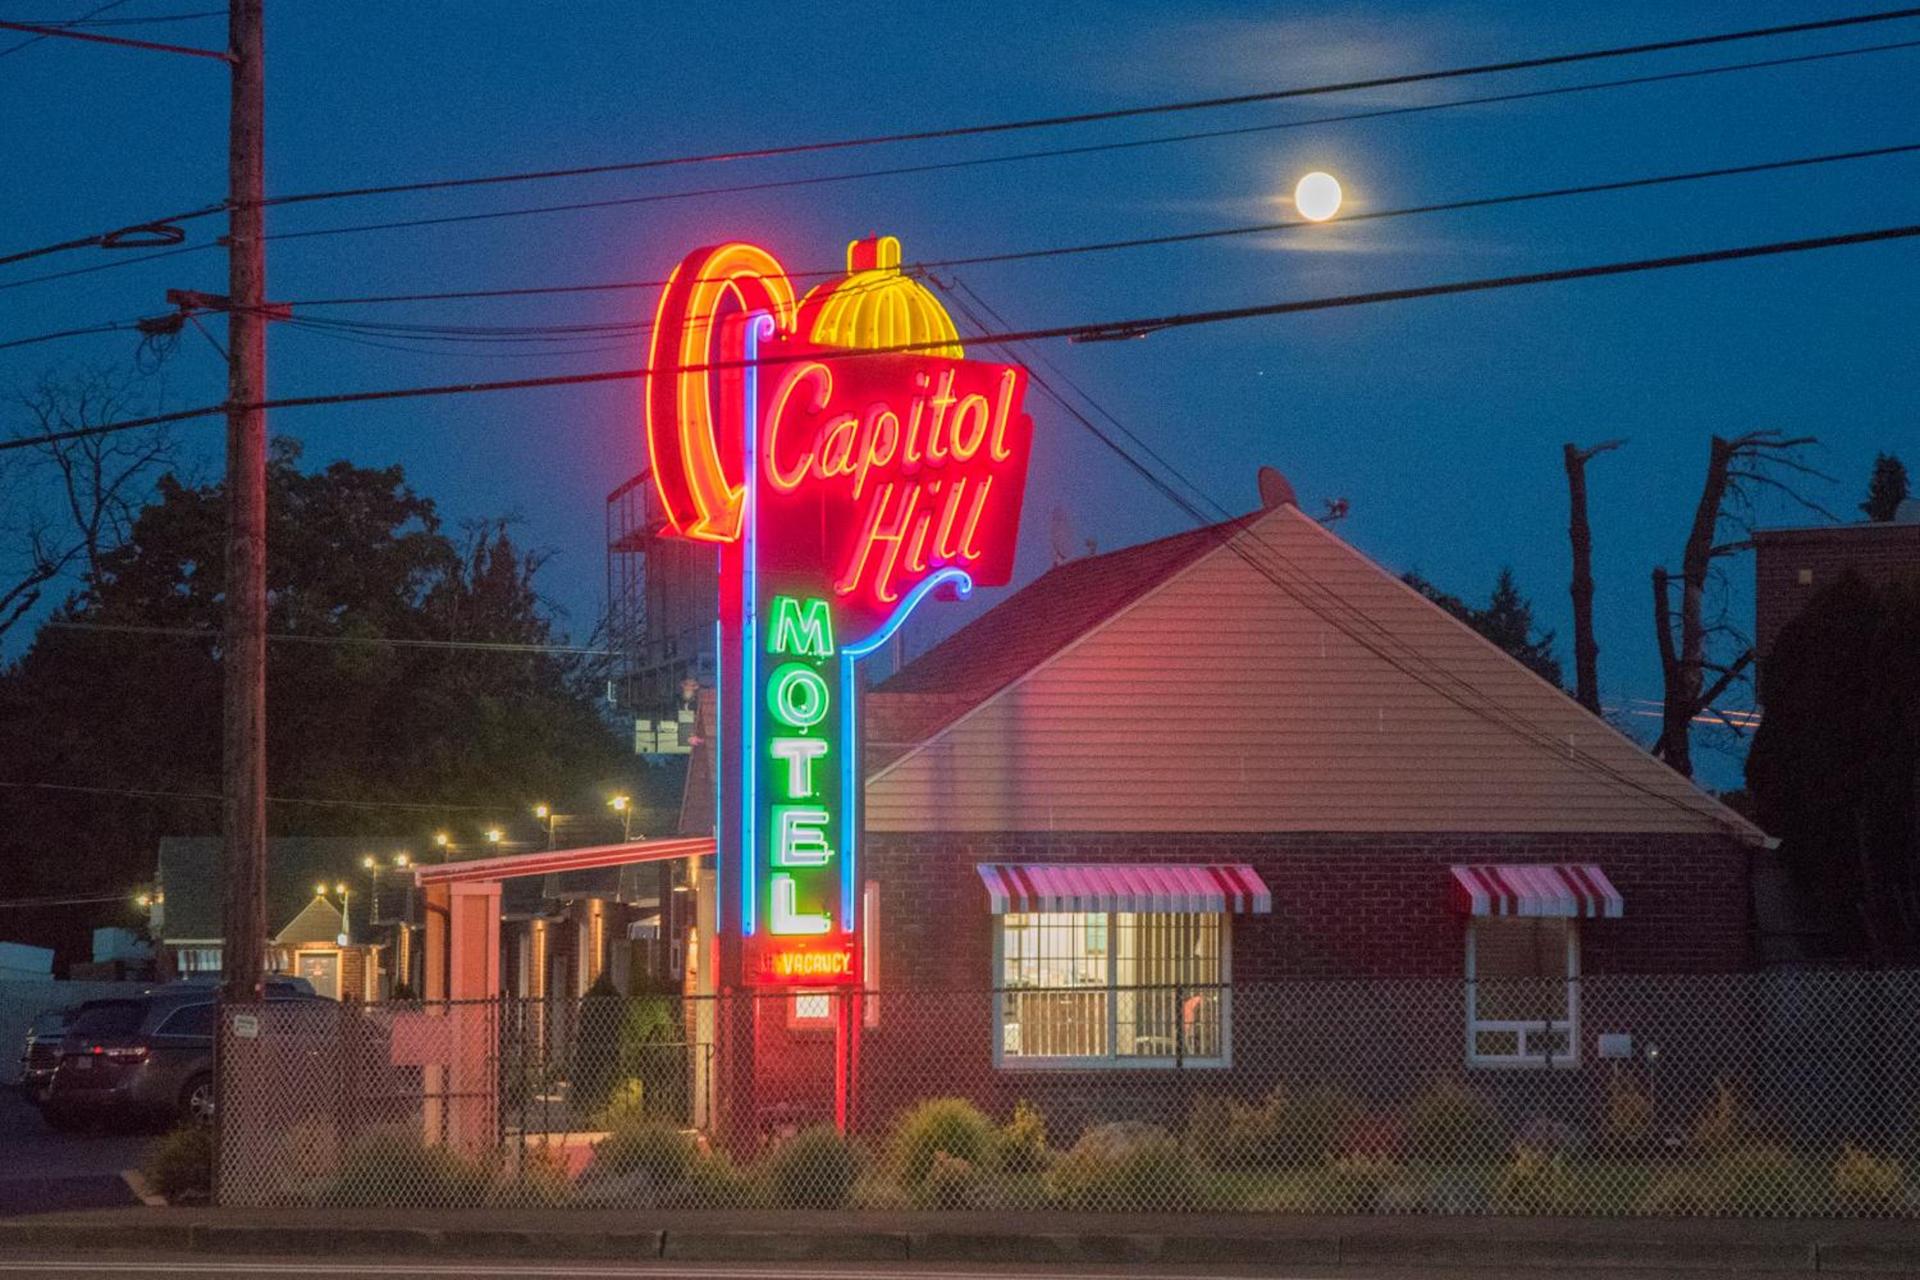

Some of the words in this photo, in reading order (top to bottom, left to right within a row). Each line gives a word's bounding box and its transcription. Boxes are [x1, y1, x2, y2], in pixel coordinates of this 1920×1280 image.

[764, 362, 1016, 500] Capitol
[834, 475, 992, 602] Hill
[766, 595, 834, 936] MOTEL
[783, 952, 851, 975] VACANCY
